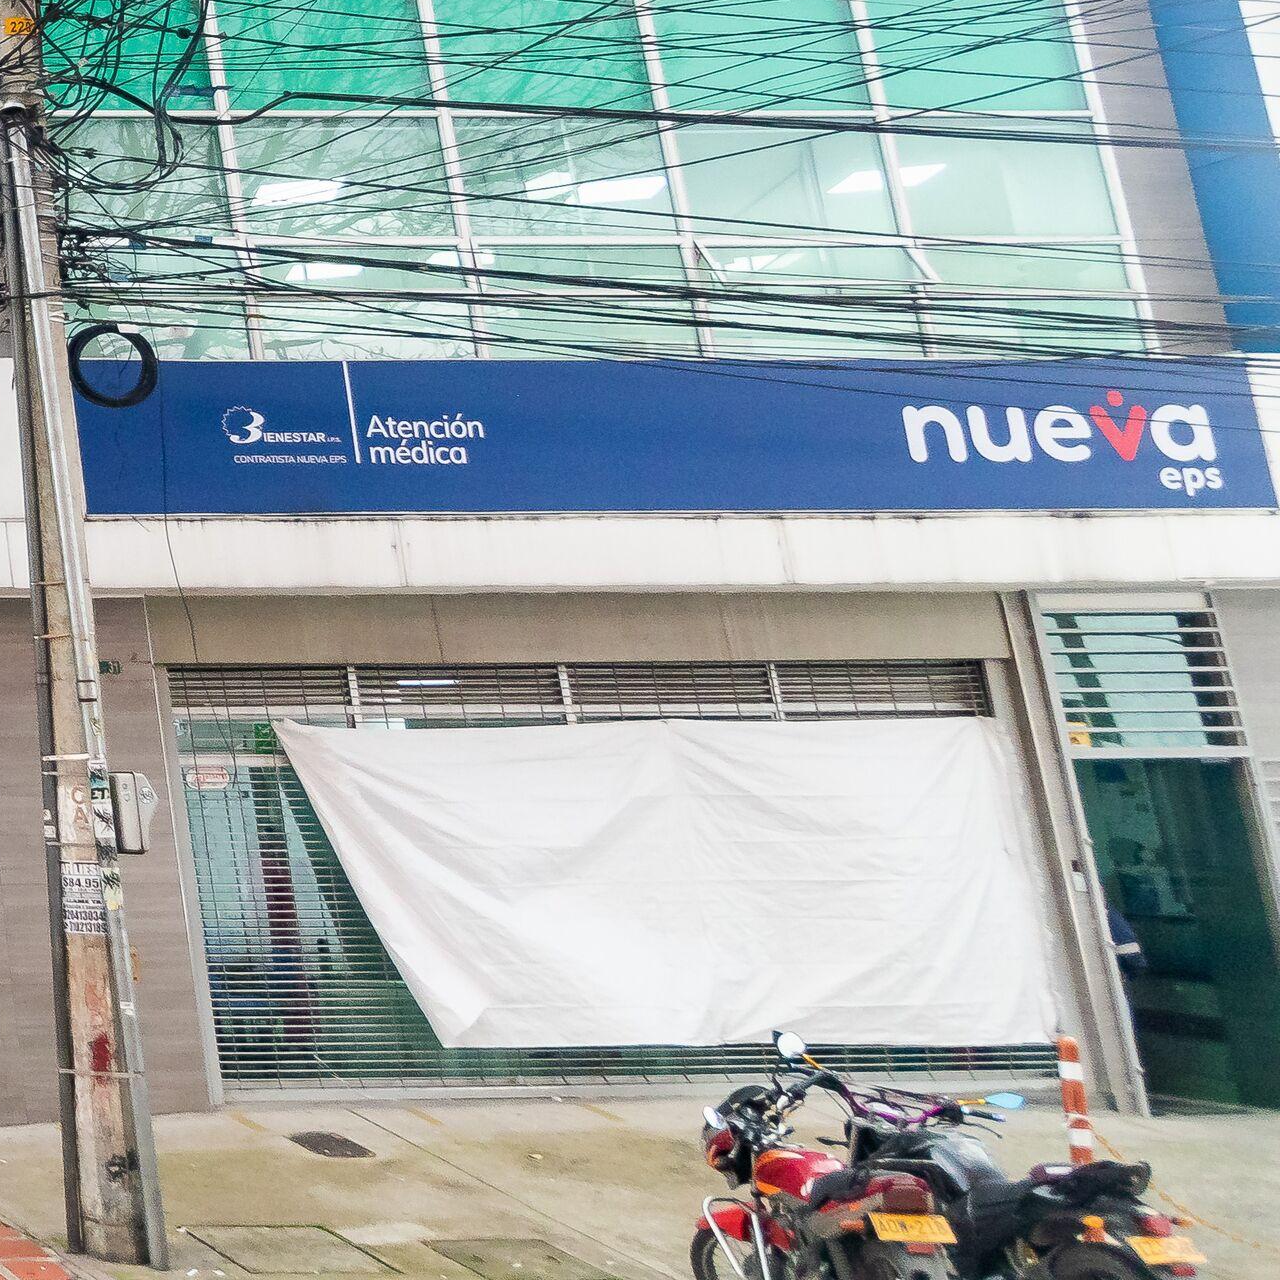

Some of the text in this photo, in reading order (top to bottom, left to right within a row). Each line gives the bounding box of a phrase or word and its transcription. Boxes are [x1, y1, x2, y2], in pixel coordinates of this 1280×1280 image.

[366, 413, 485, 439] Atención
[902, 390, 1217, 463] nueva
[233, 455, 348, 464] CONTRATISTA NUEVA EPS
[369, 440, 468, 465] médica
[1159, 466, 1223, 496] eps
